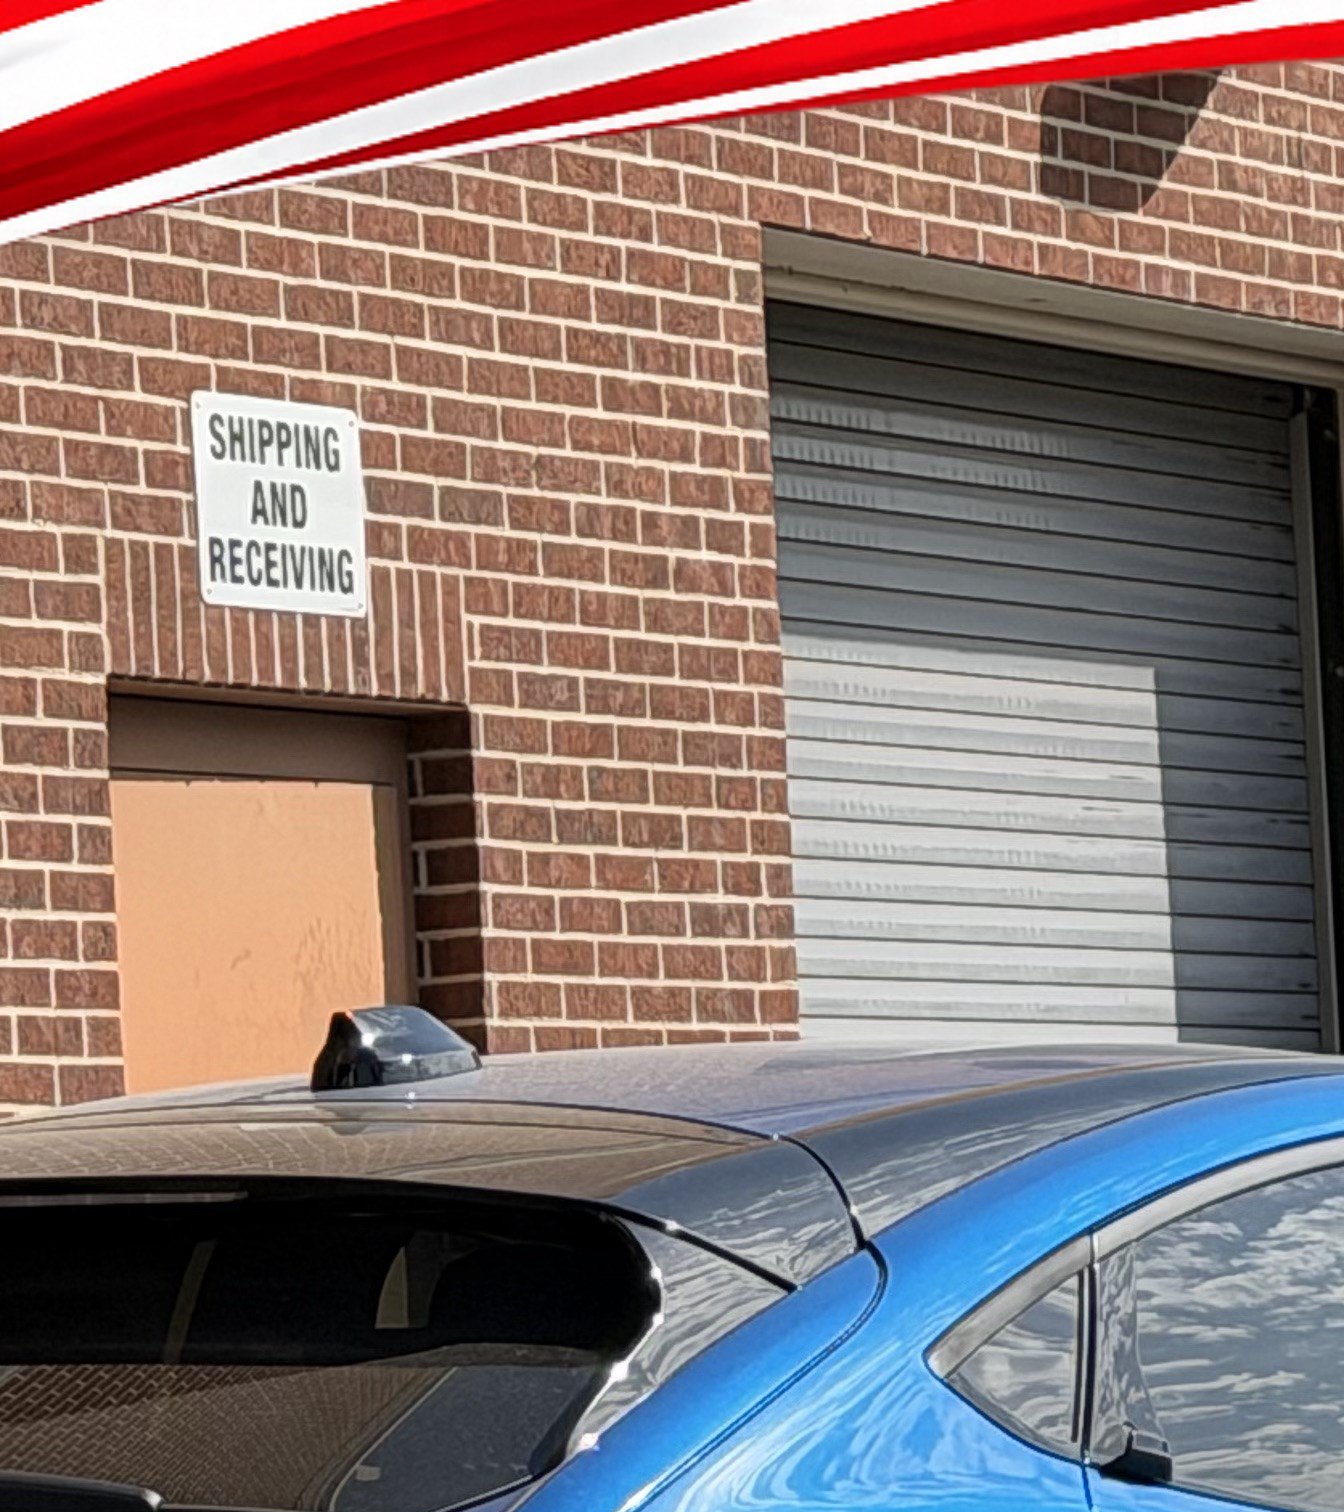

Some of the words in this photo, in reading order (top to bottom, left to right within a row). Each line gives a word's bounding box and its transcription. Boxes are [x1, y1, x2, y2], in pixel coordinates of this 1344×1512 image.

[208, 413, 341, 473] SHIPPING
[250, 480, 308, 529] AND
[208, 536, 355, 595] RECEIVING
